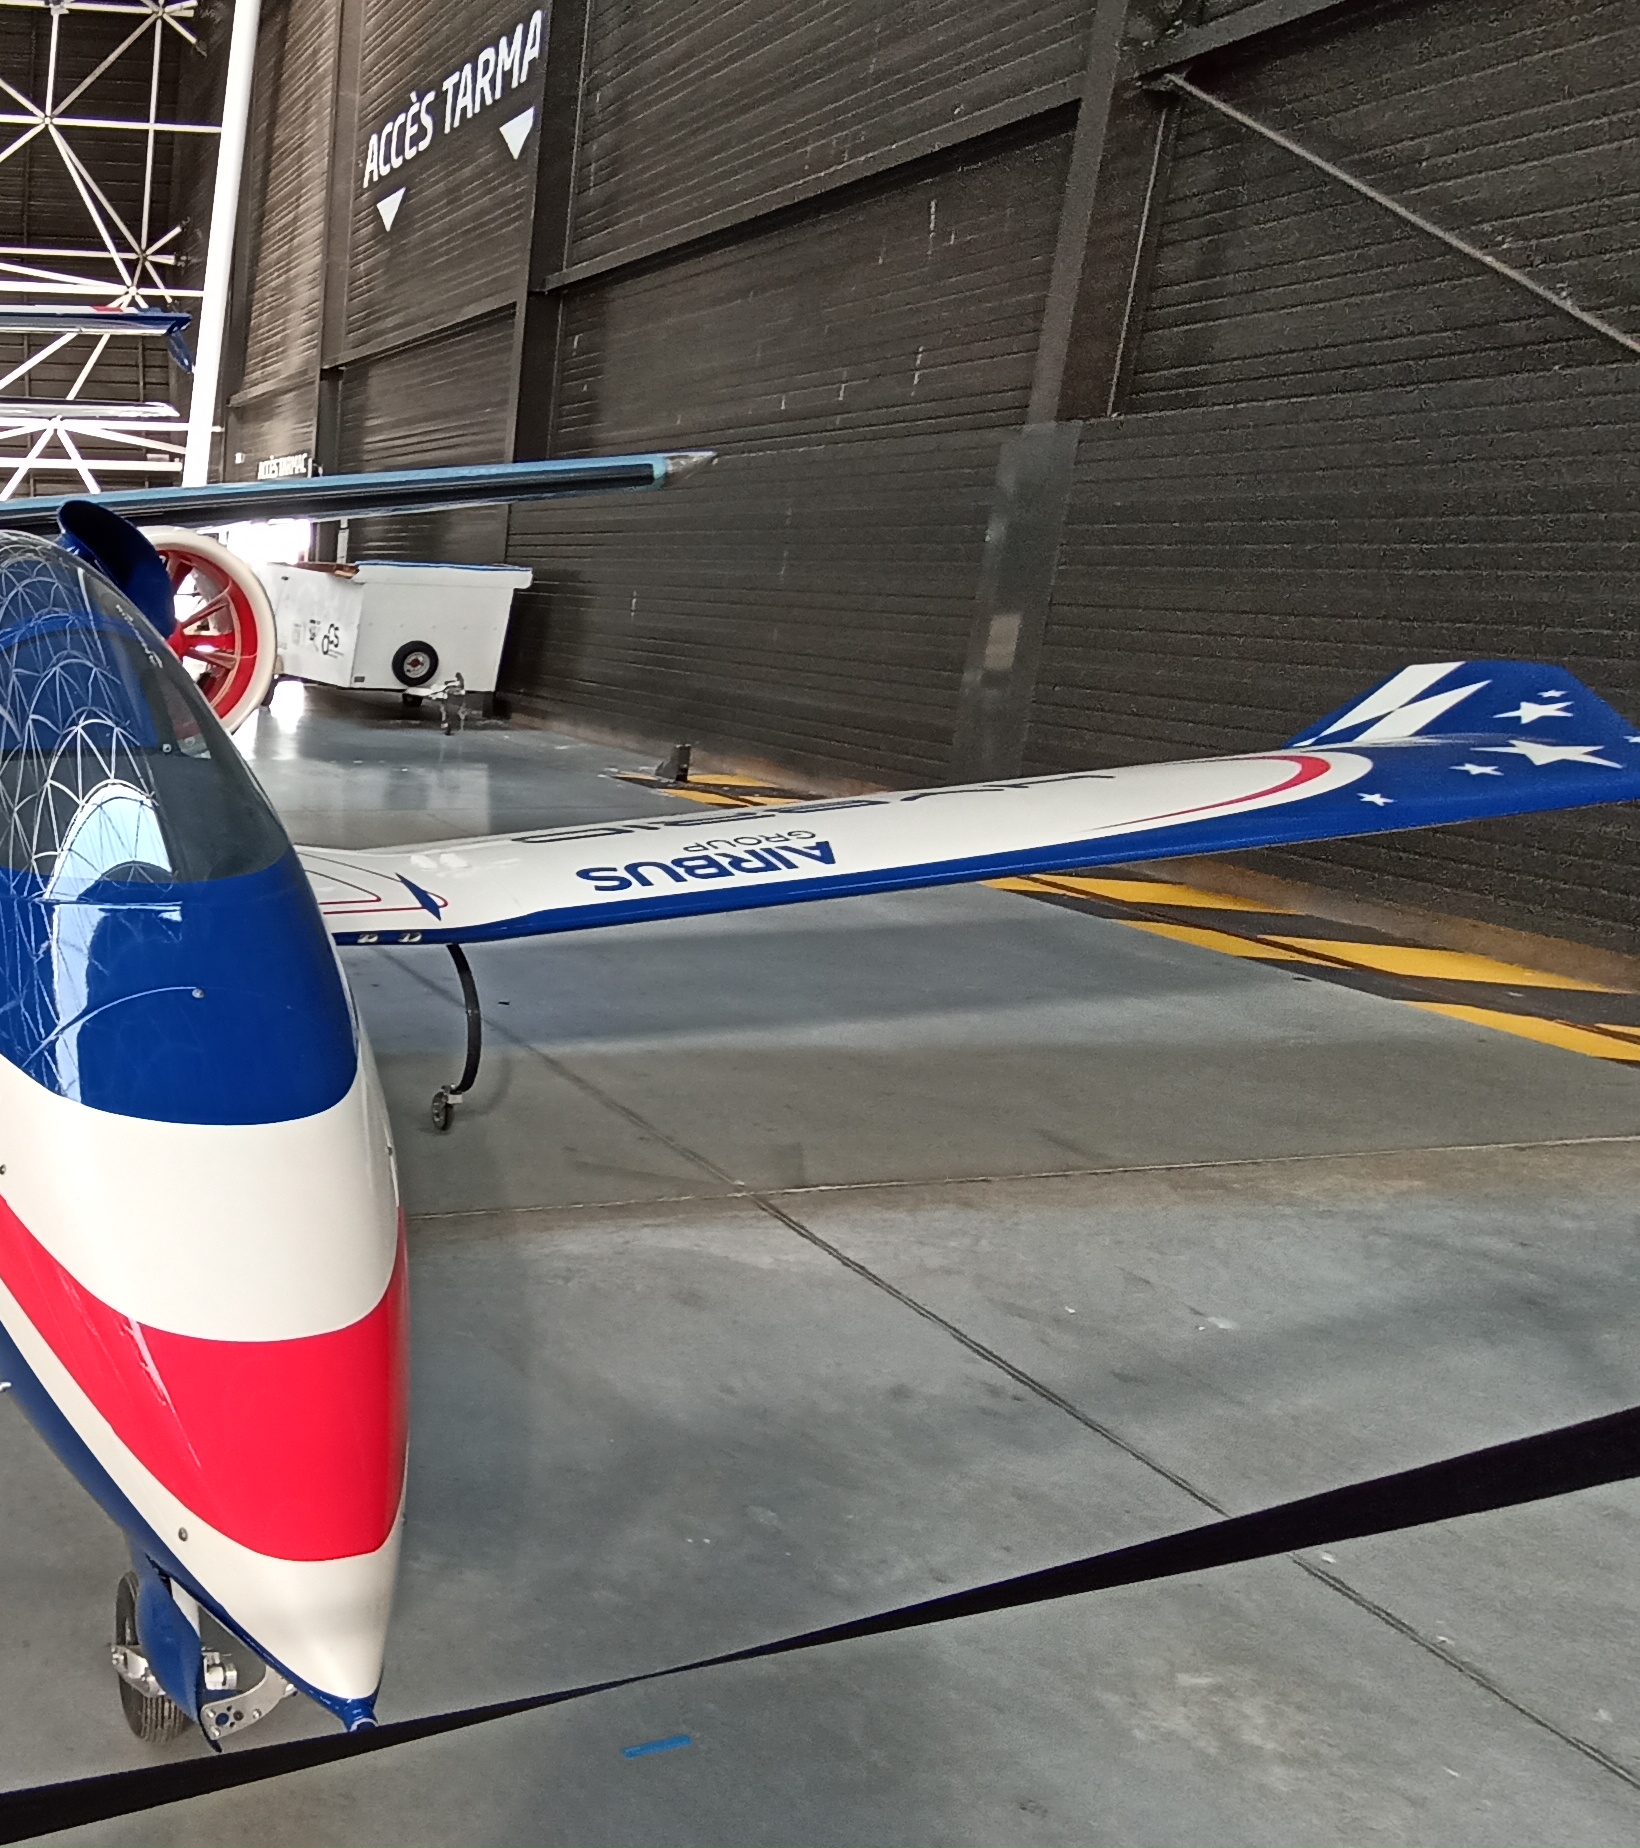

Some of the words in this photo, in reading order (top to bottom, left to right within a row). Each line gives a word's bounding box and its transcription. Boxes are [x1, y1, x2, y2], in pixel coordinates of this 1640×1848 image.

[363, 90, 436, 189] ACCÈS
[442, 9, 542, 134] TARMA
[575, 840, 837, 892] AIRBUS
[682, 829, 817, 852] GROUP
